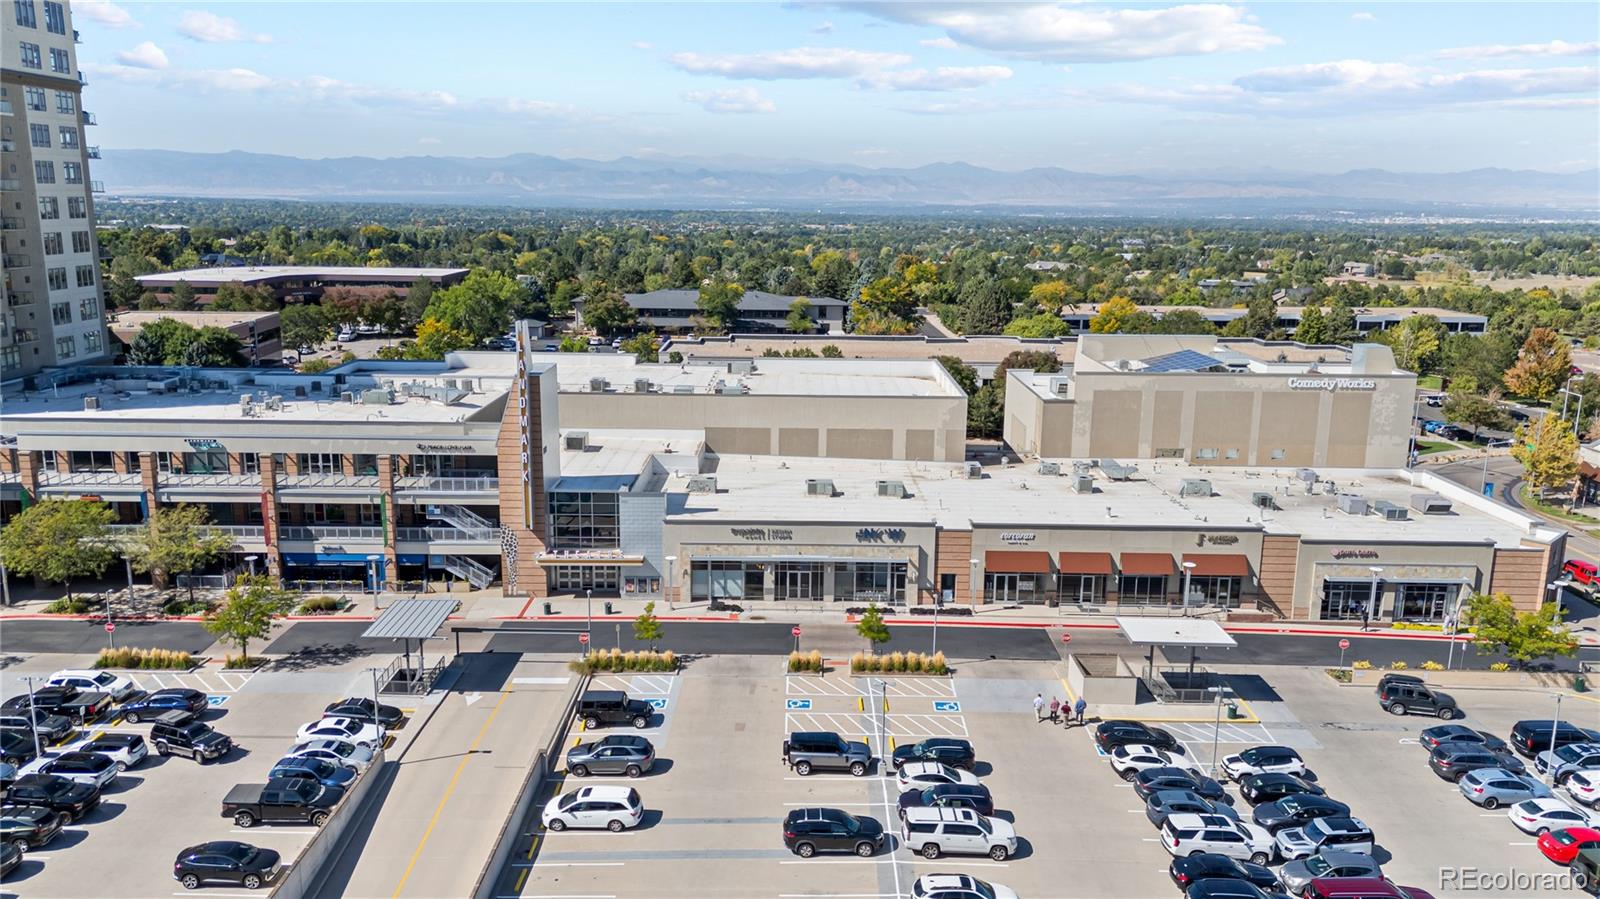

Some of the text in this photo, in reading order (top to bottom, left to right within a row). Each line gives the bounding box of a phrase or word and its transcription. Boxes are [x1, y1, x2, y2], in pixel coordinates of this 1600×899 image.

[516, 341, 529, 482] LANDMARK
[1288, 377, 1375, 391] Comedy Works
